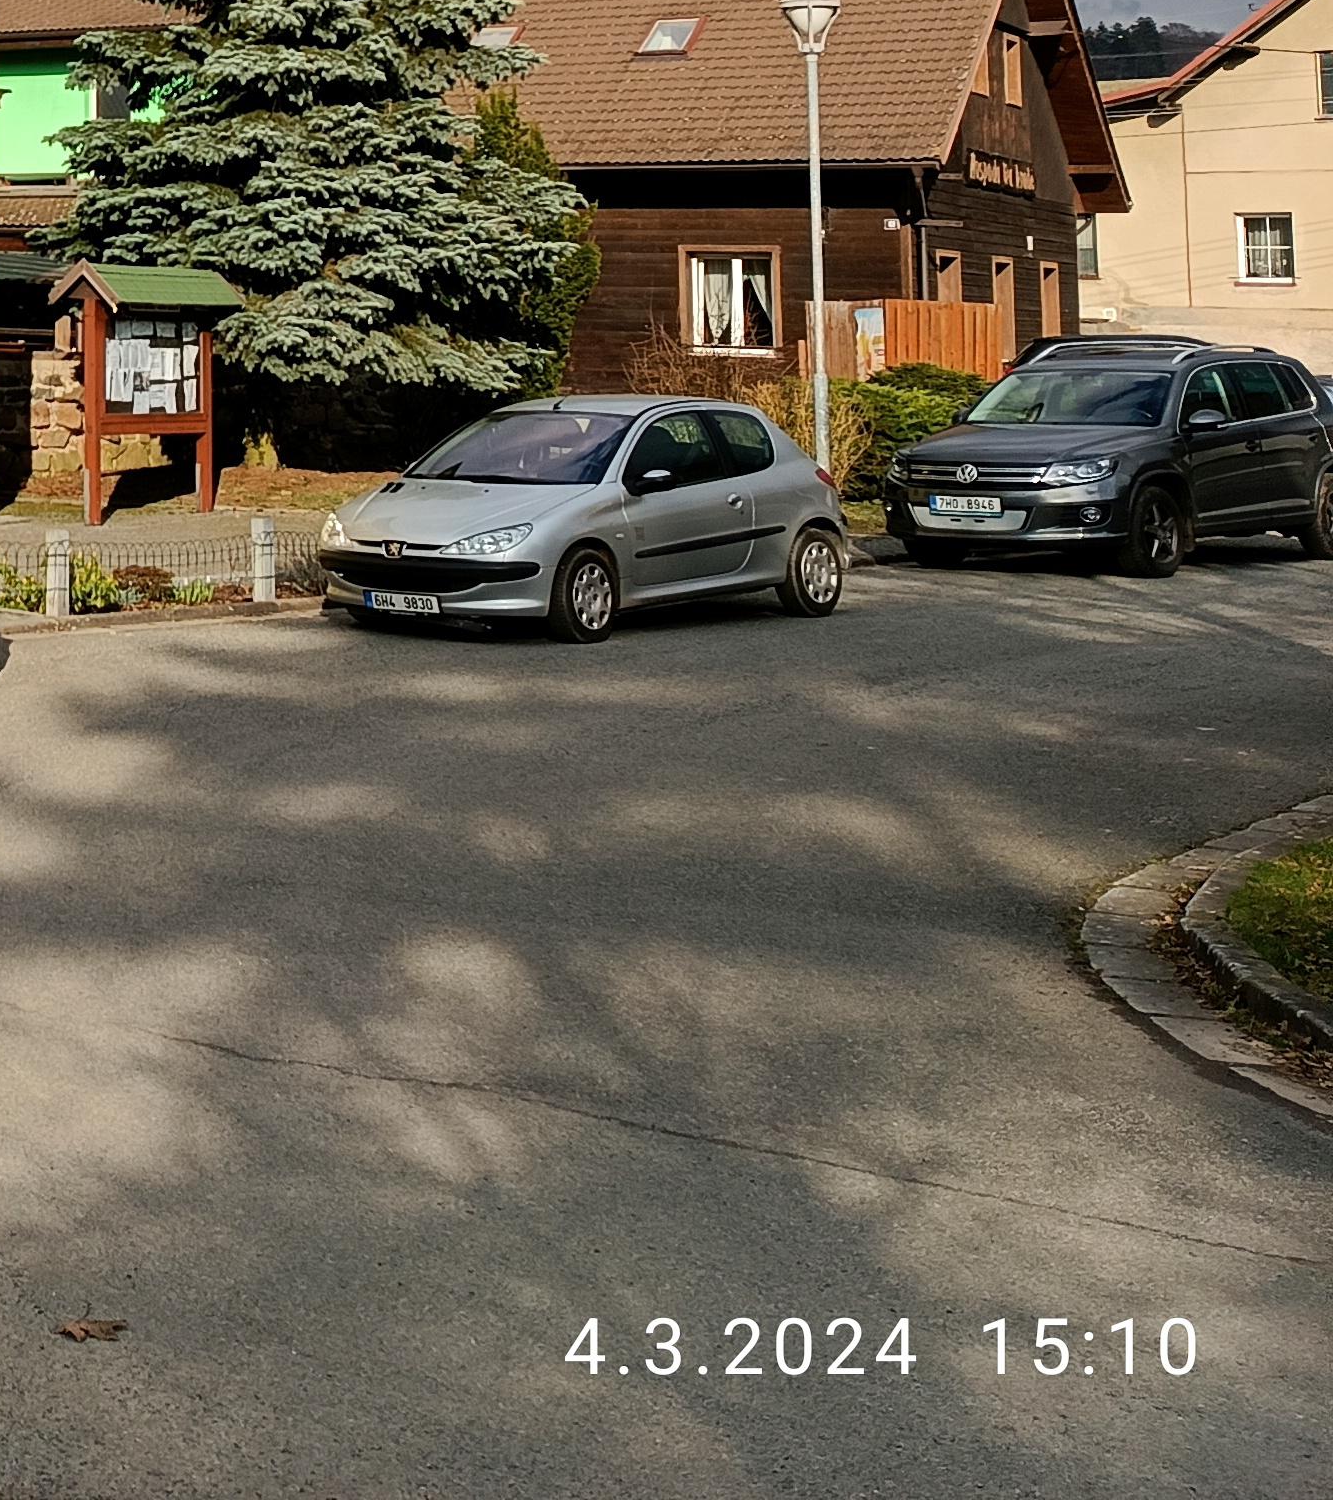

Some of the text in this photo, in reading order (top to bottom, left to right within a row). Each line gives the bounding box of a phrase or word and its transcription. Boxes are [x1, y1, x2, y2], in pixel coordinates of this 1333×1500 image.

[967, 498, 995, 511] 8946
[374, 593, 433, 611] 6H4 9830
